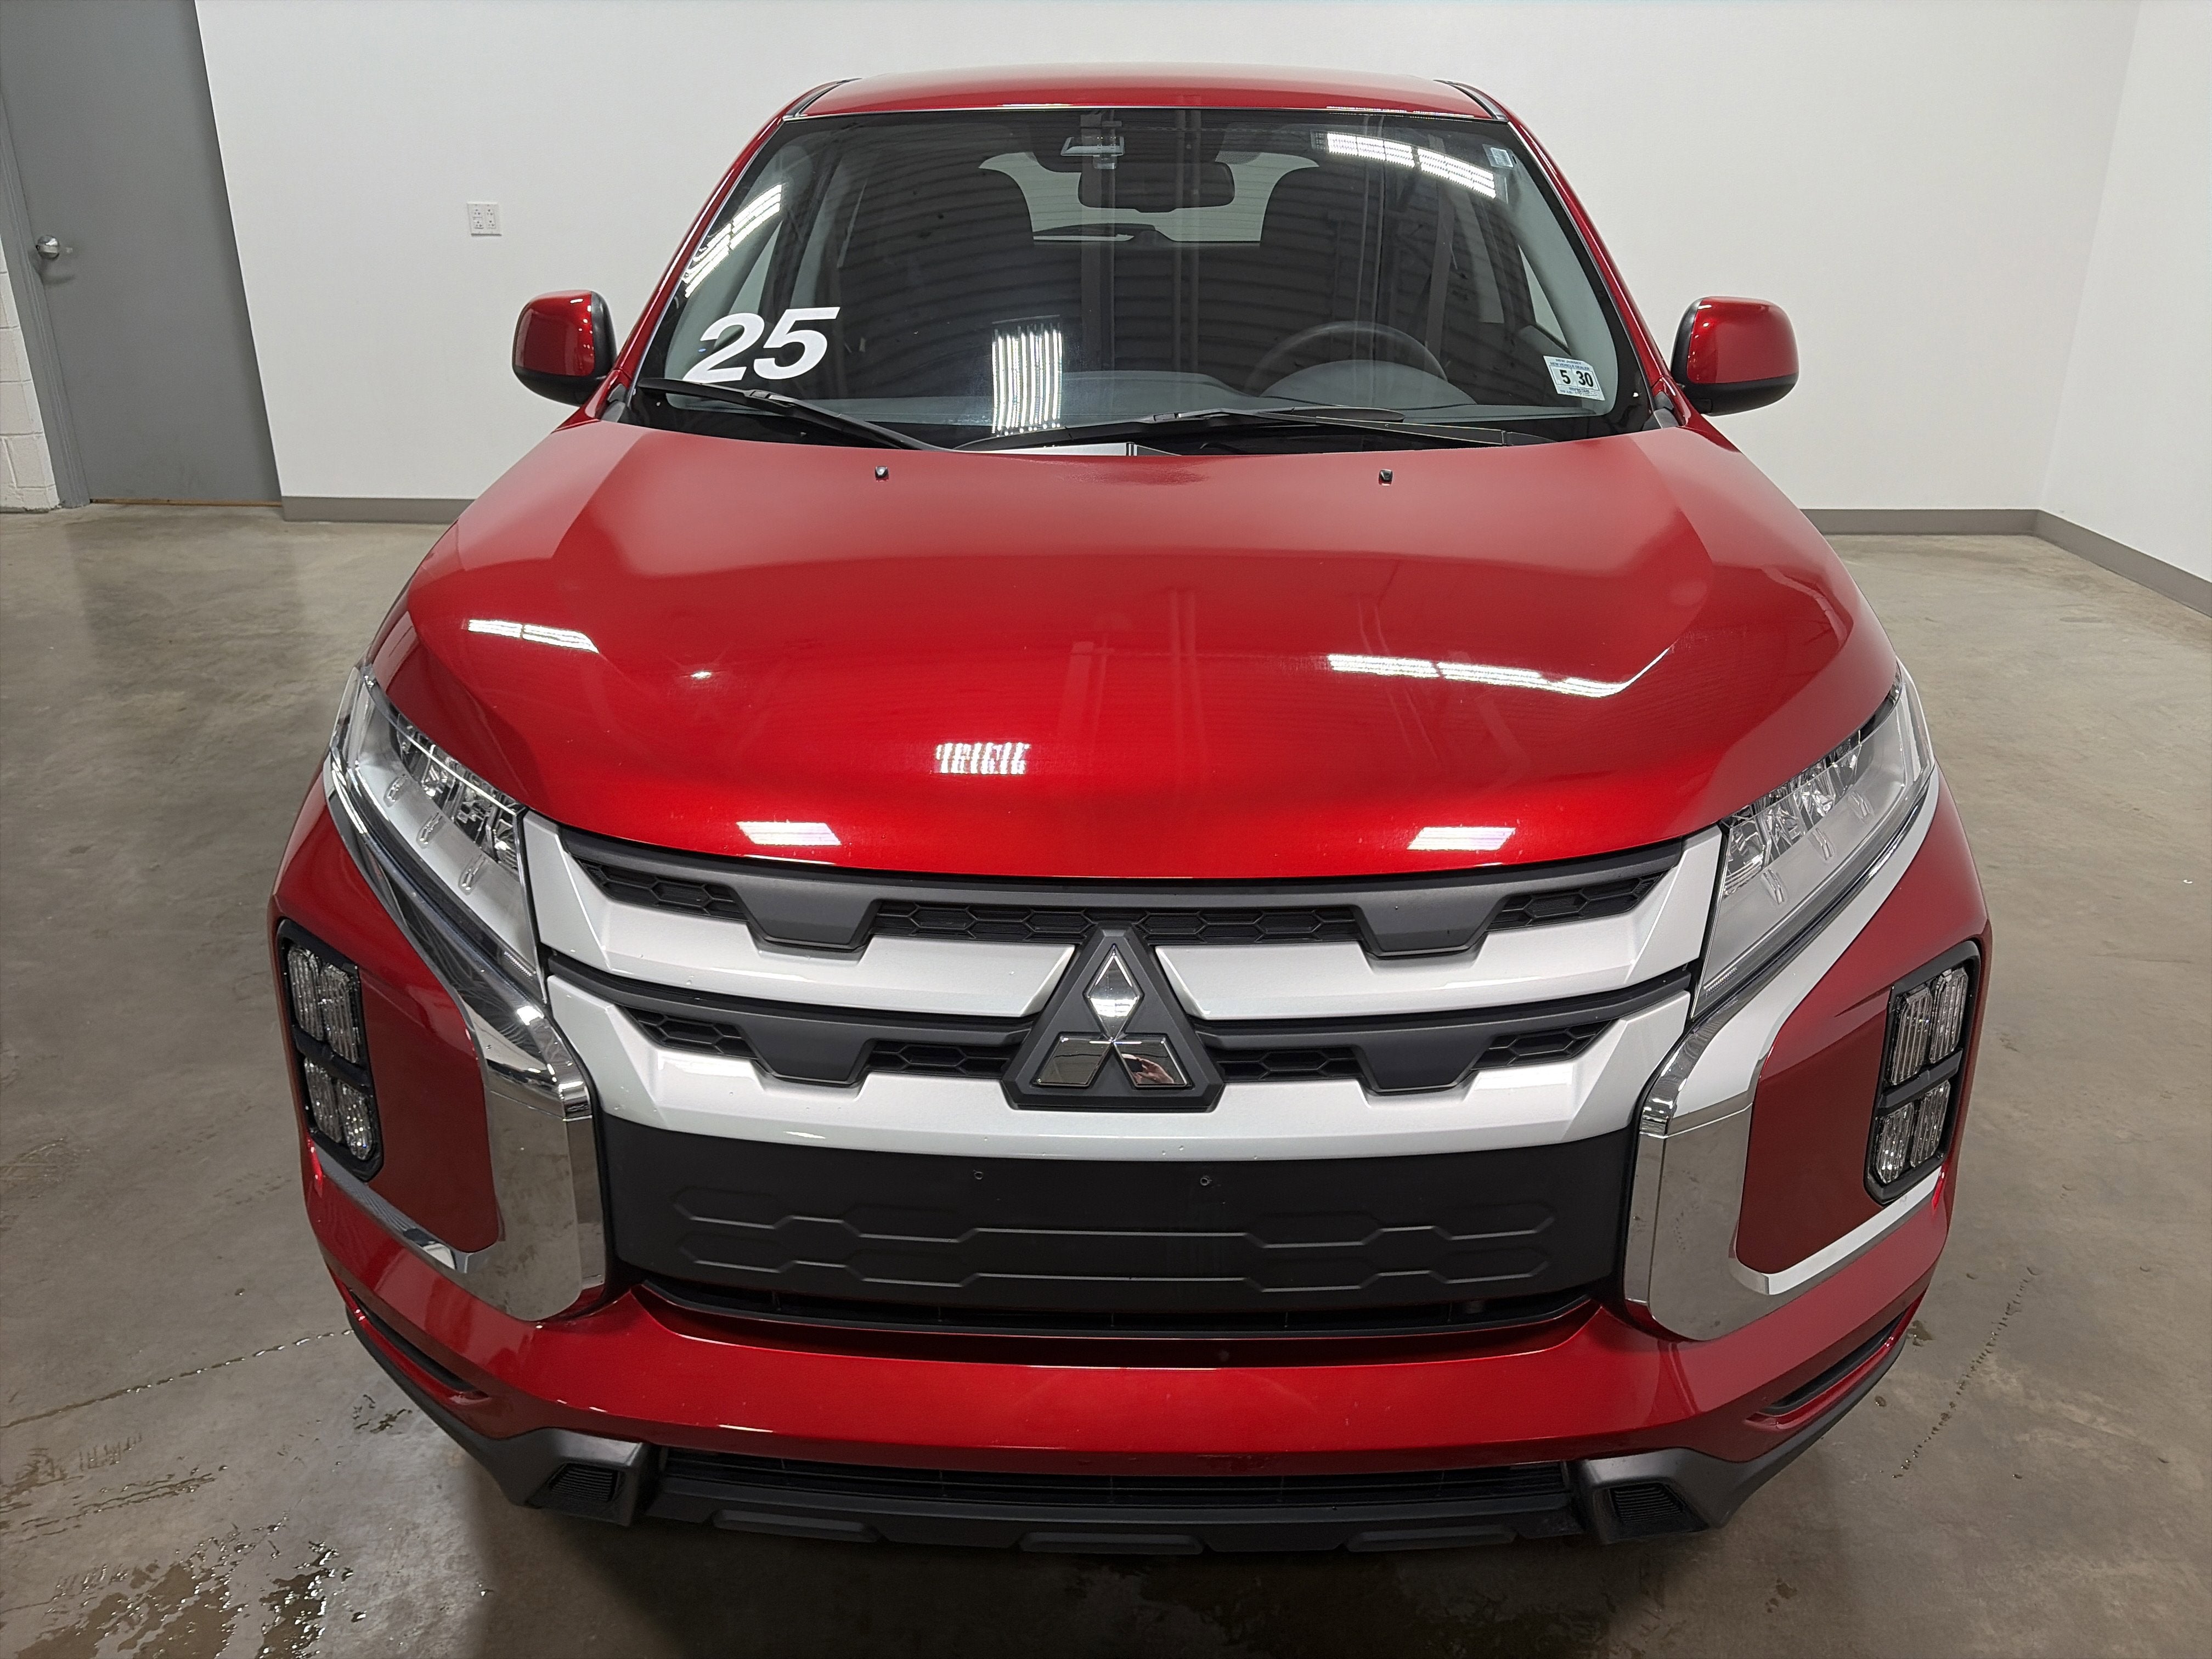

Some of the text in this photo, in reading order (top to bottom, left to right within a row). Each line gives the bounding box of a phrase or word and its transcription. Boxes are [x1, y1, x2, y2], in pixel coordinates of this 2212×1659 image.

[682, 307, 840, 383] 25
[1560, 369, 1594, 387] 5 30
